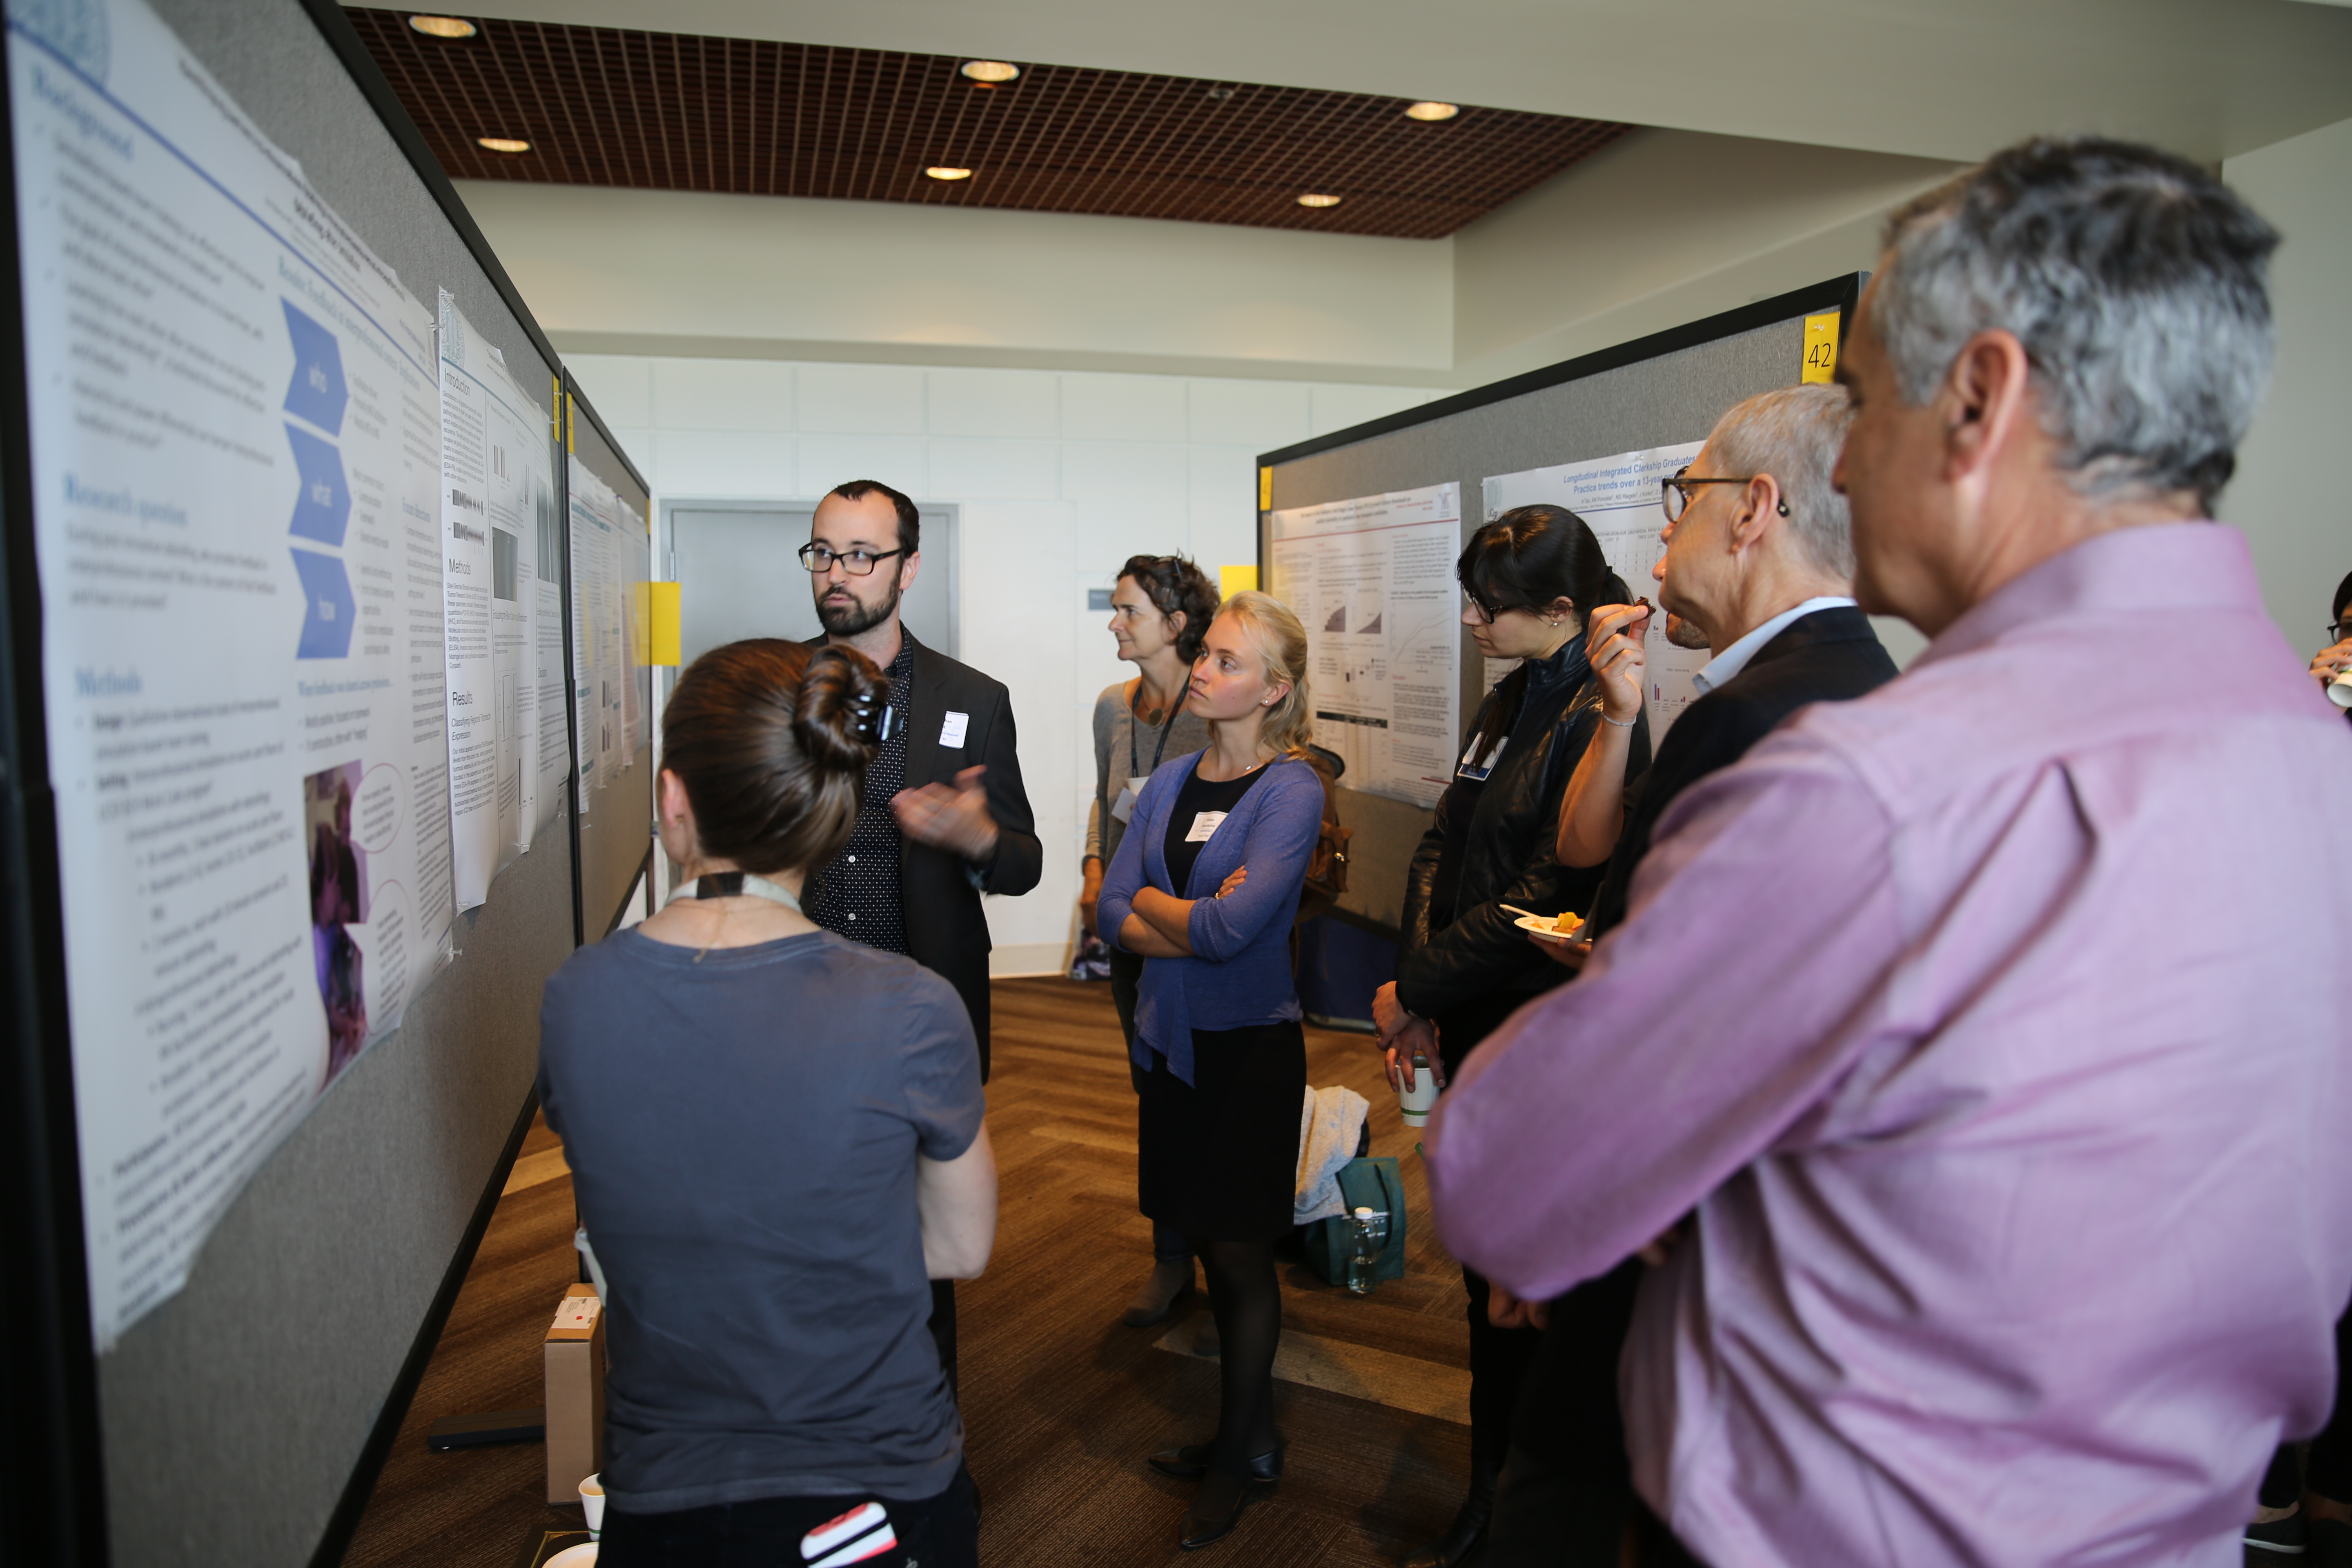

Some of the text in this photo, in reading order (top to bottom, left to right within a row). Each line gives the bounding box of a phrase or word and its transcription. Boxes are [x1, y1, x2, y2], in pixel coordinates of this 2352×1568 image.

[1808, 343, 1831, 368] 42
[445, 368, 470, 397] Introduction
[1564, 455, 1696, 483] Longitudinal Integrated Clerkship Graduates
[1574, 483, 1597, 494] Practice
[1598, 481, 1618, 490] trends
[1620, 479, 1635, 488] over
[1642, 476, 1663, 486] 13-year
[449, 558, 471, 575] Methods
[452, 690, 472, 706] Results
[452, 717, 470, 728] Classifying
[452, 730, 471, 742] Expression
